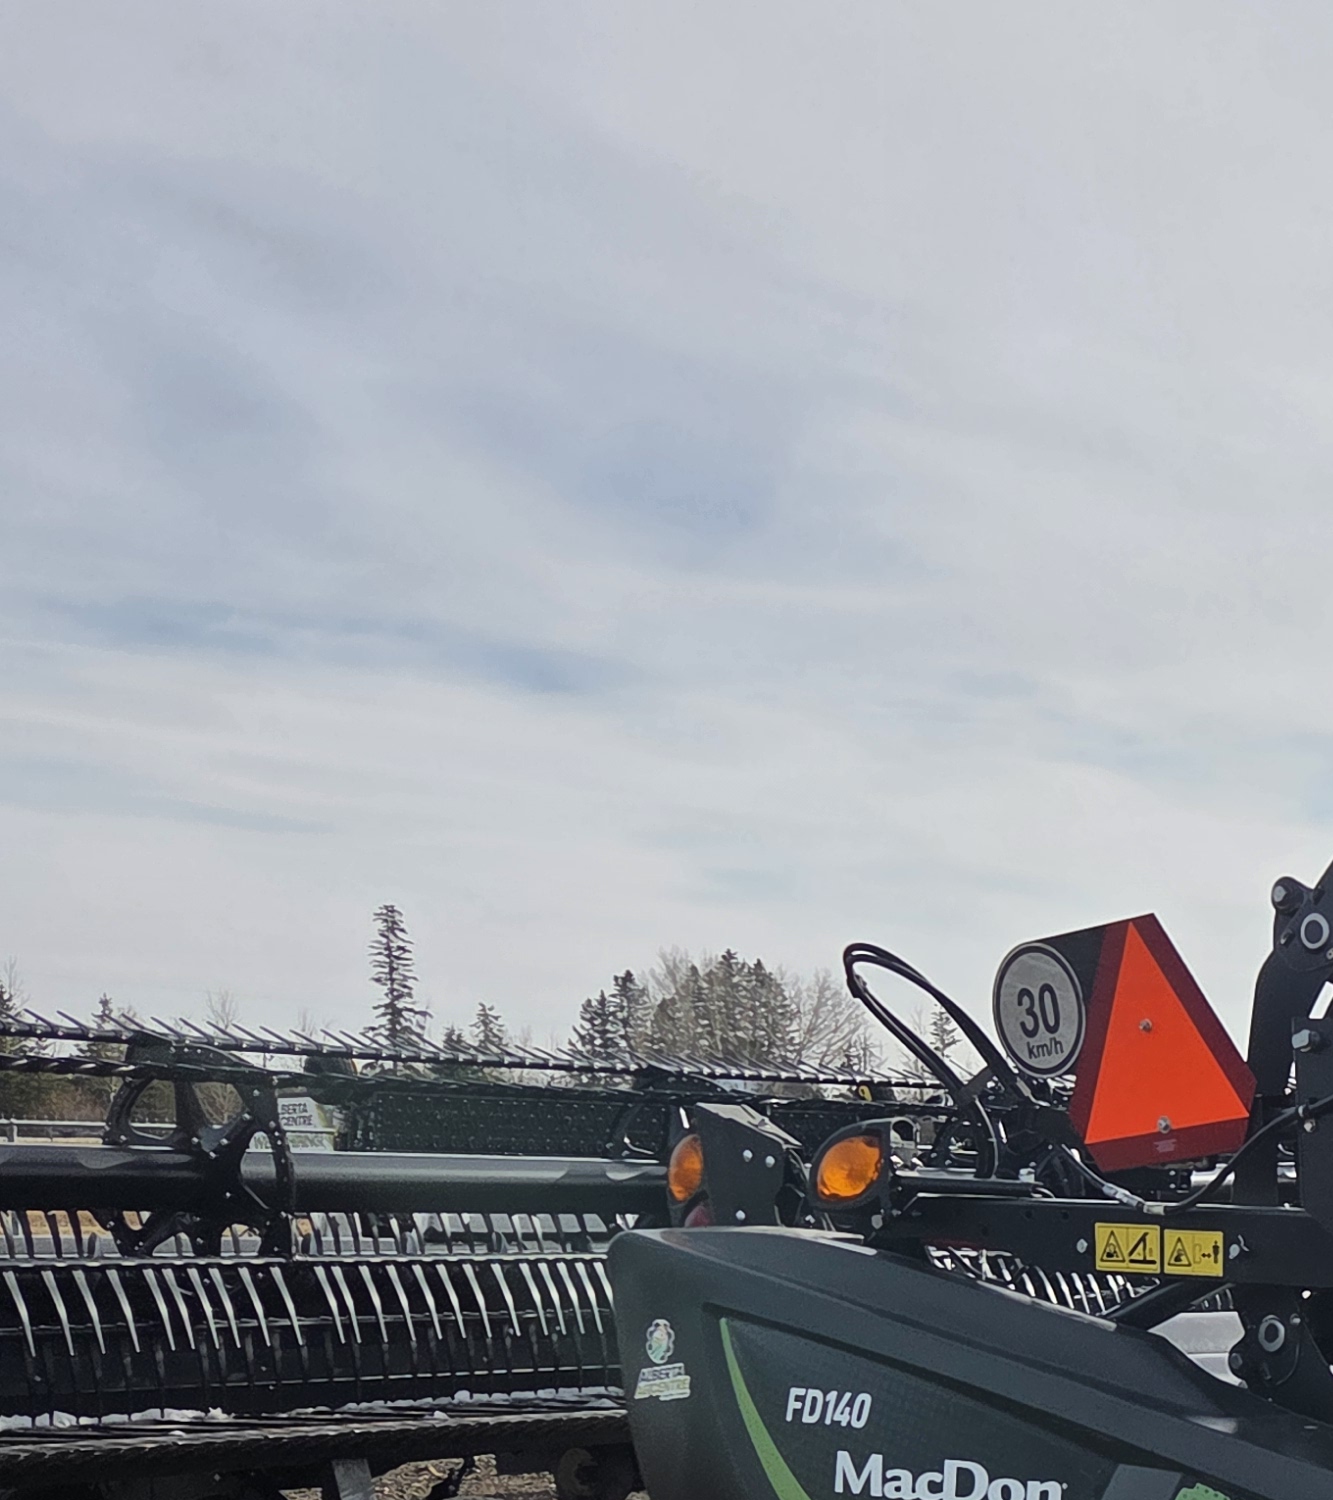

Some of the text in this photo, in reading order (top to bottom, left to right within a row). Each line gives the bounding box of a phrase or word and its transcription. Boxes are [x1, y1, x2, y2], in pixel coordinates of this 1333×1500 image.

[1017, 983, 1060, 1038] 30
[1026, 1036, 1065, 1060] km/h
[785, 1387, 872, 1429] FD140
